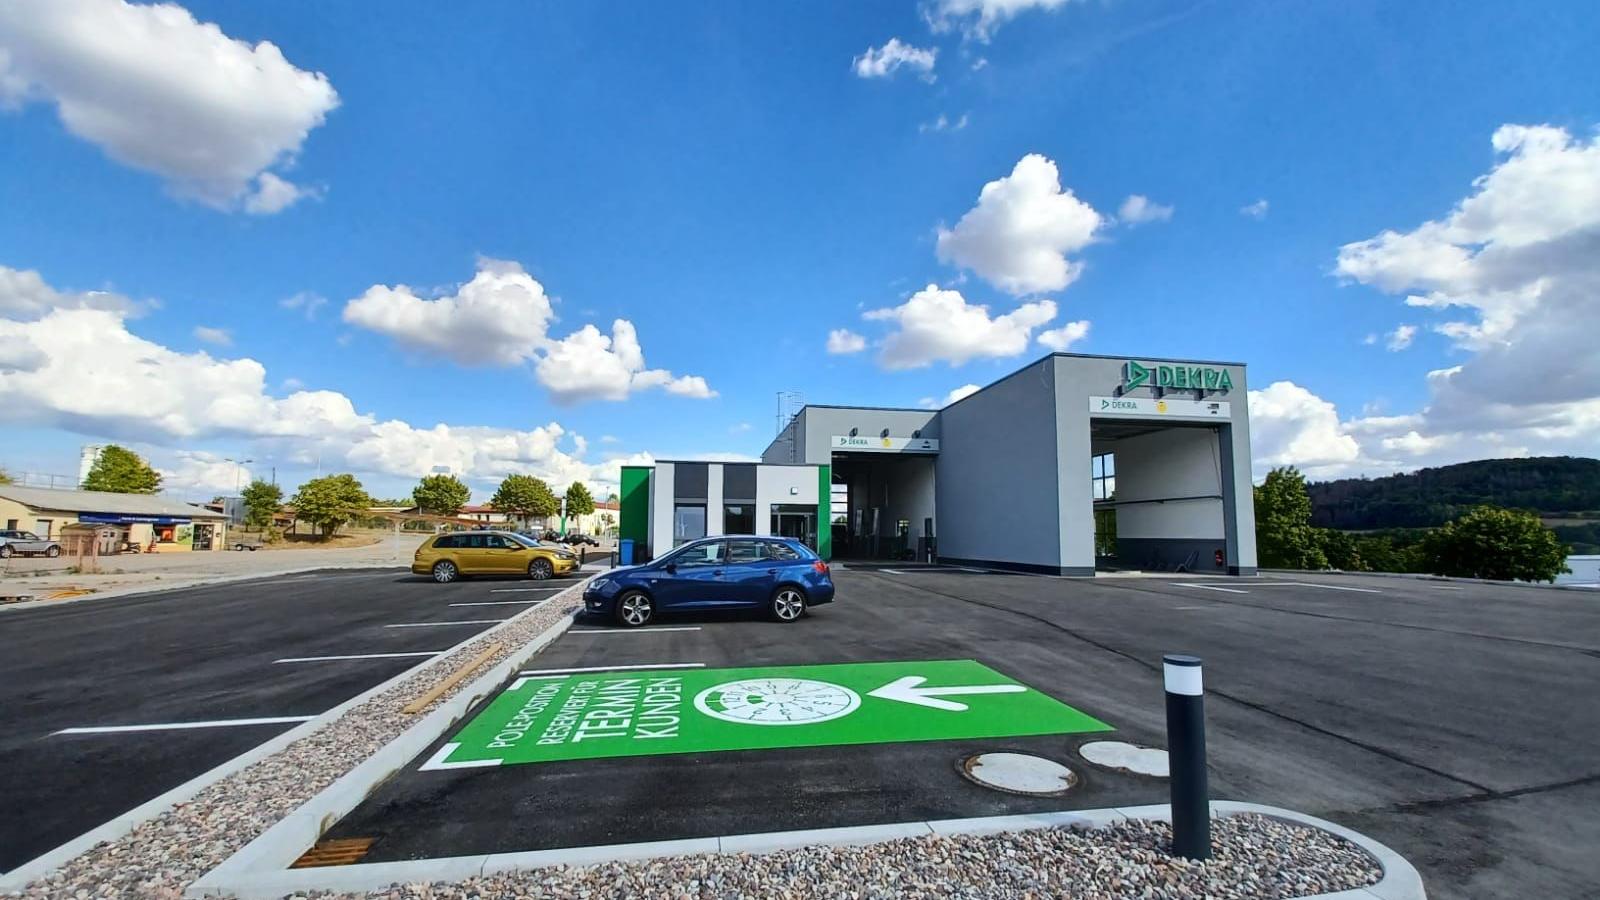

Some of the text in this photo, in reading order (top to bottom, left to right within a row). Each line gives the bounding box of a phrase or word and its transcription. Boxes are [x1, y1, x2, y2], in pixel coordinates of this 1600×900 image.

[1112, 401, 1137, 410] DEKRA
[1158, 365, 1233, 390] DEKRA
[486, 683, 564, 749] POLE-POSITION
[536, 680, 600, 745] RESERVIERT FÜR
[572, 679, 644, 743] TERMIN
[633, 677, 683, 739] KUNDEN
